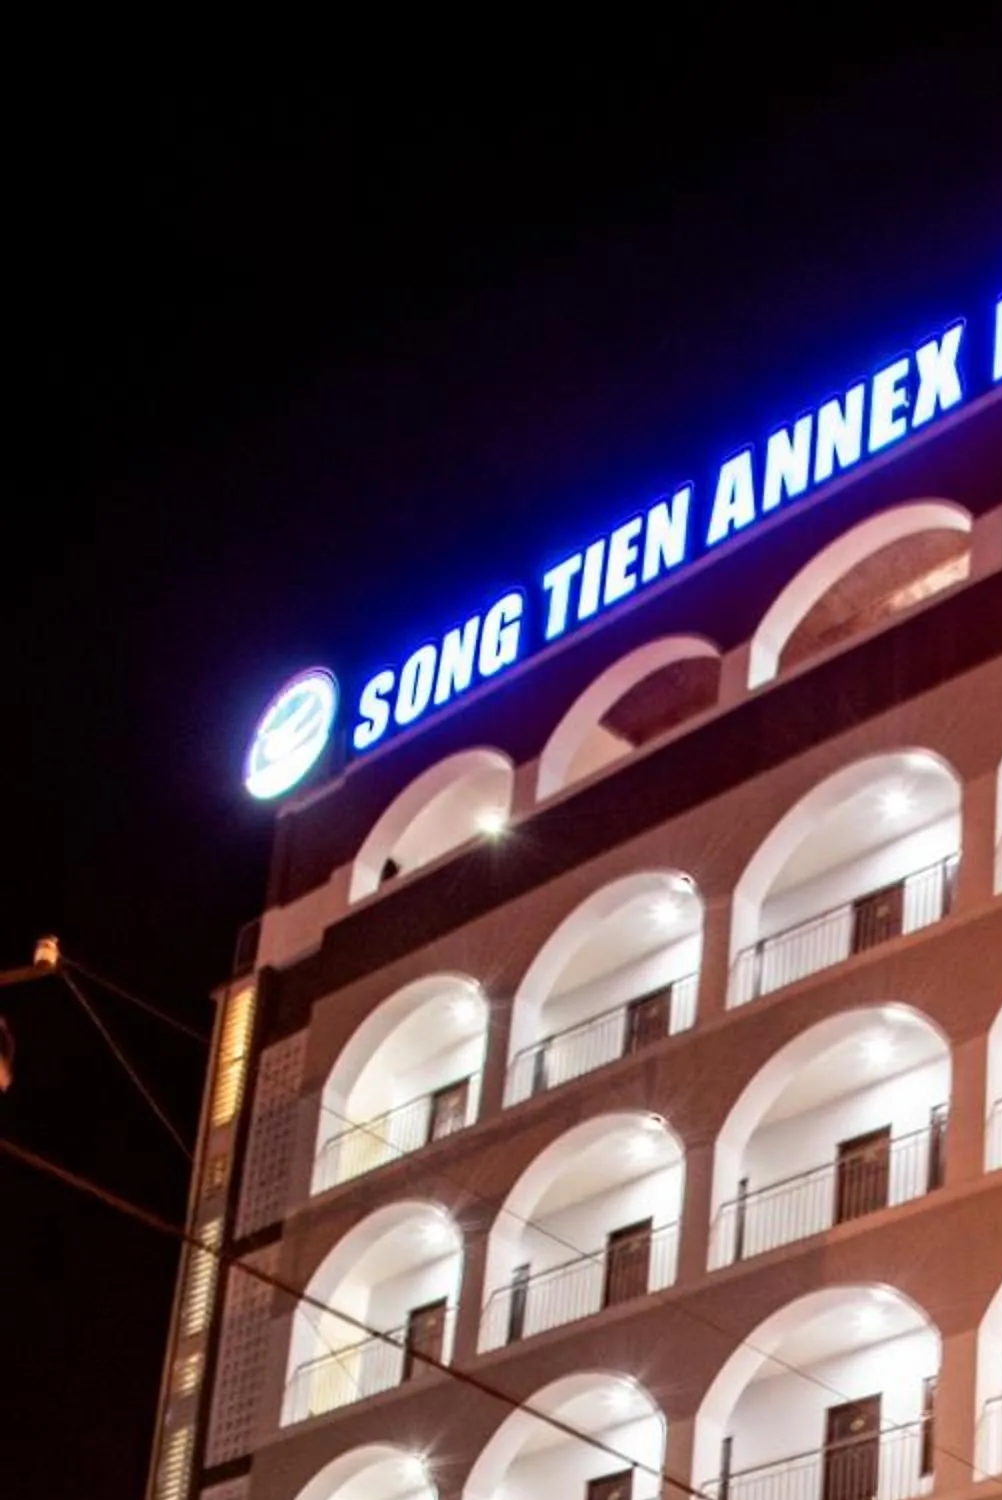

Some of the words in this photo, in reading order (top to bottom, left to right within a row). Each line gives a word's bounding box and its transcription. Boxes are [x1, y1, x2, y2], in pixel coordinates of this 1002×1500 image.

[353, 592, 524, 751] SONG
[542, 486, 692, 641] TIEN
[705, 323, 965, 547] ANNEX
